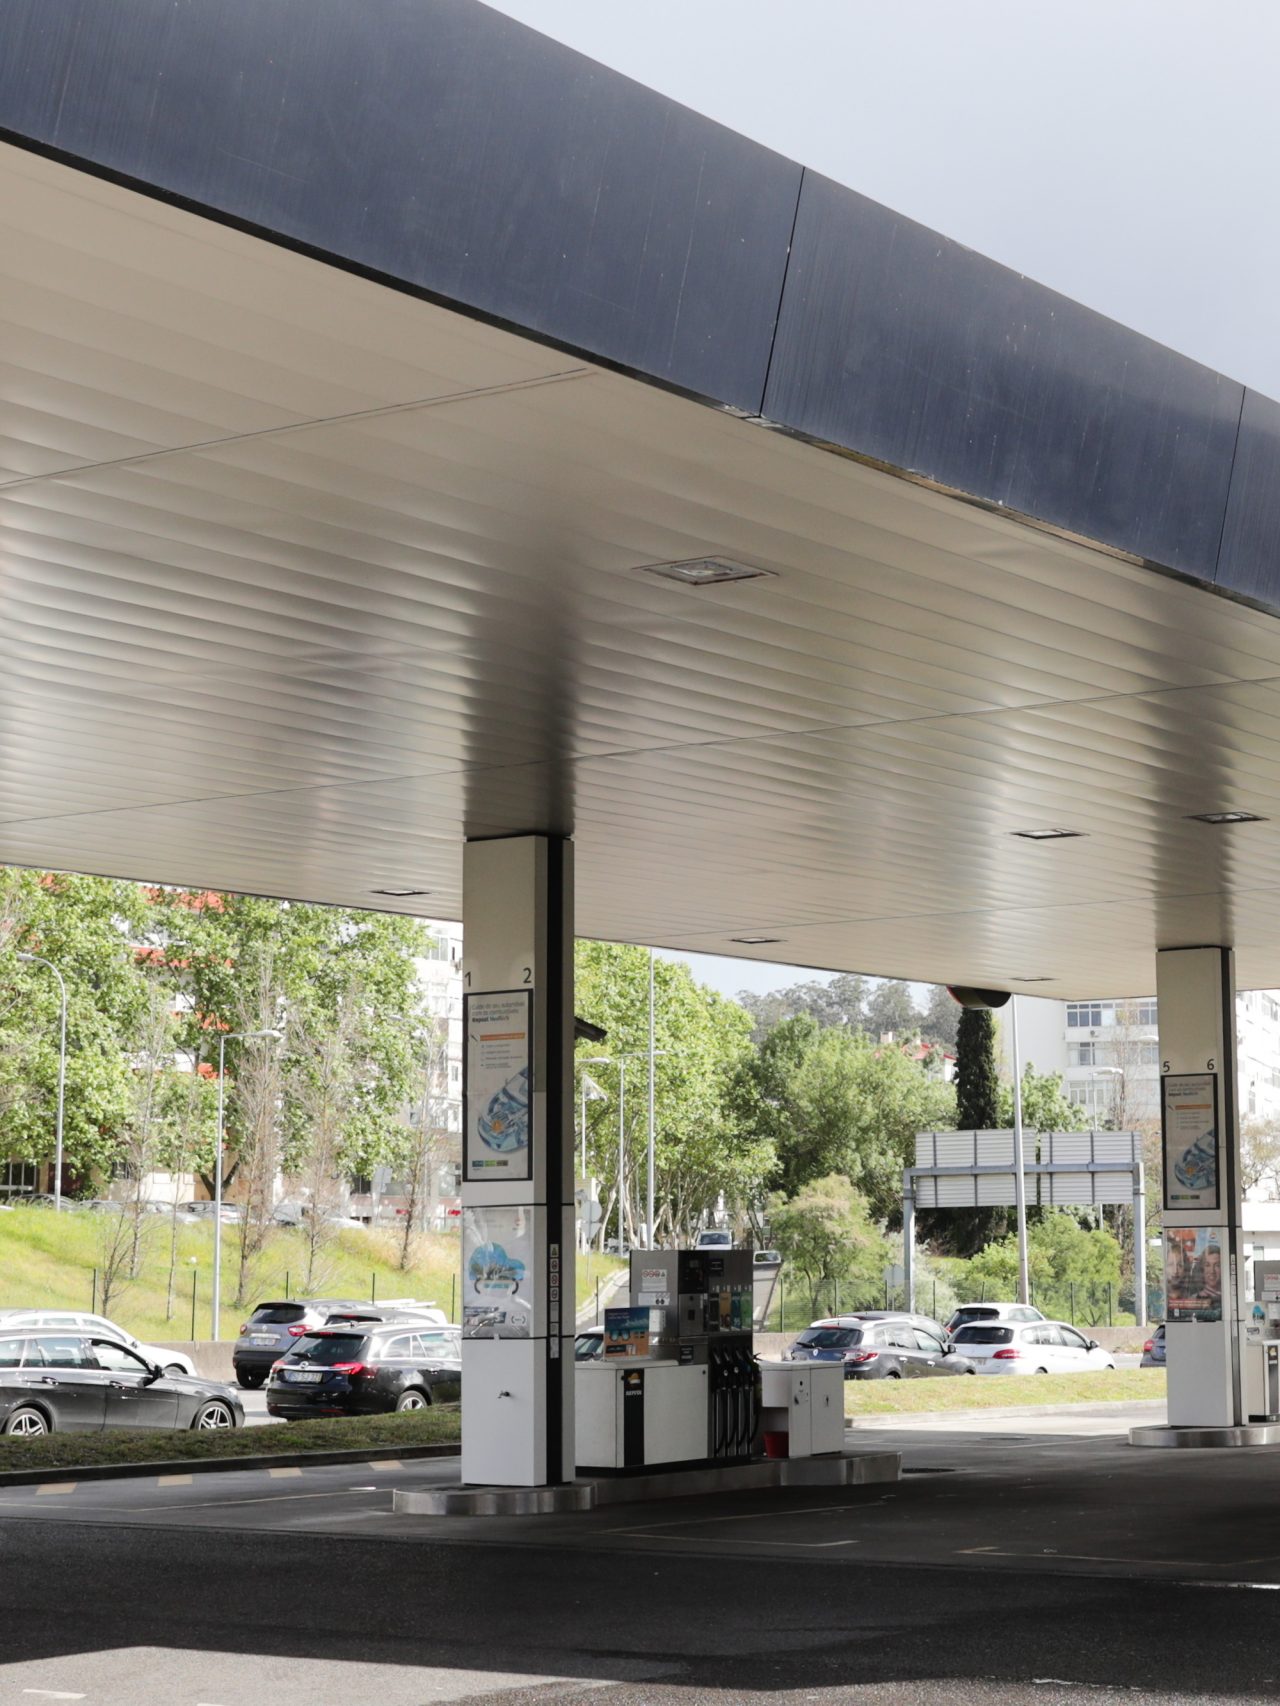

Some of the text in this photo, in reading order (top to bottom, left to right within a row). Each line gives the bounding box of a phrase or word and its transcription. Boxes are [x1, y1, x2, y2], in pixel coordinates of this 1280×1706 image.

[464, 971, 471, 987] 1
[523, 967, 532, 984] 2
[1162, 1061, 1170, 1073] 5
[1207, 1059, 1215, 1071] 6
